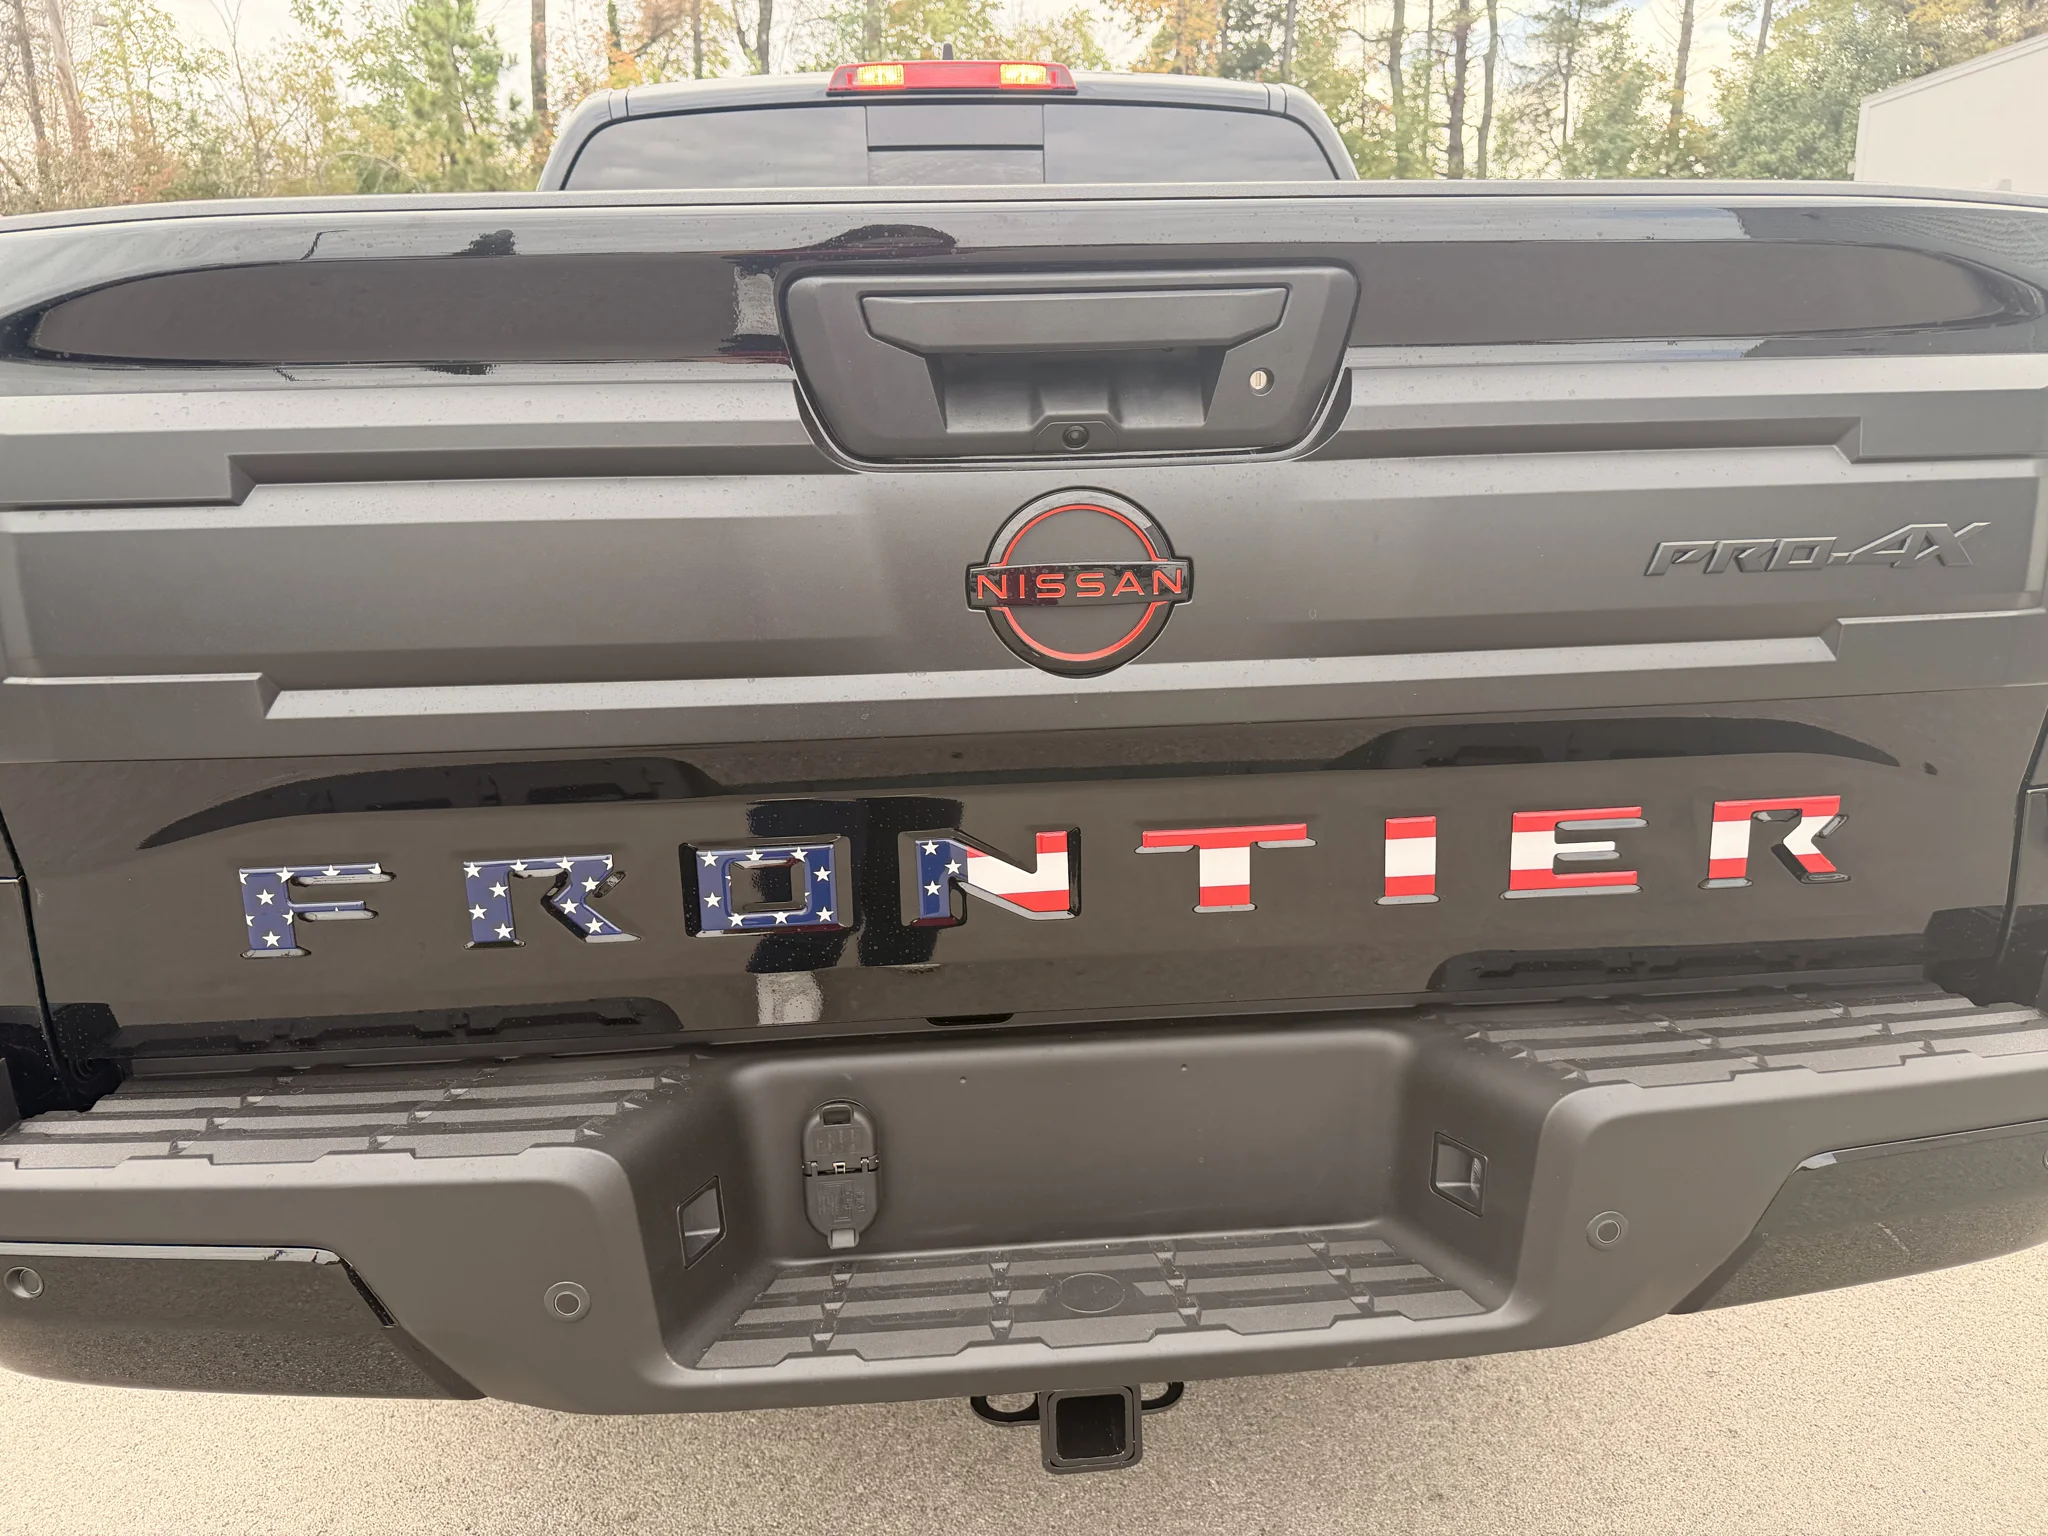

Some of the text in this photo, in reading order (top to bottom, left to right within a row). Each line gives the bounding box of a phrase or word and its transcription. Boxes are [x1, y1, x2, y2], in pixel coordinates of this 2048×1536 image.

[1644, 521, 1991, 576] PRO-4X
[976, 569, 1182, 600] NISSAN
[238, 794, 1851, 959] FRONTIER
